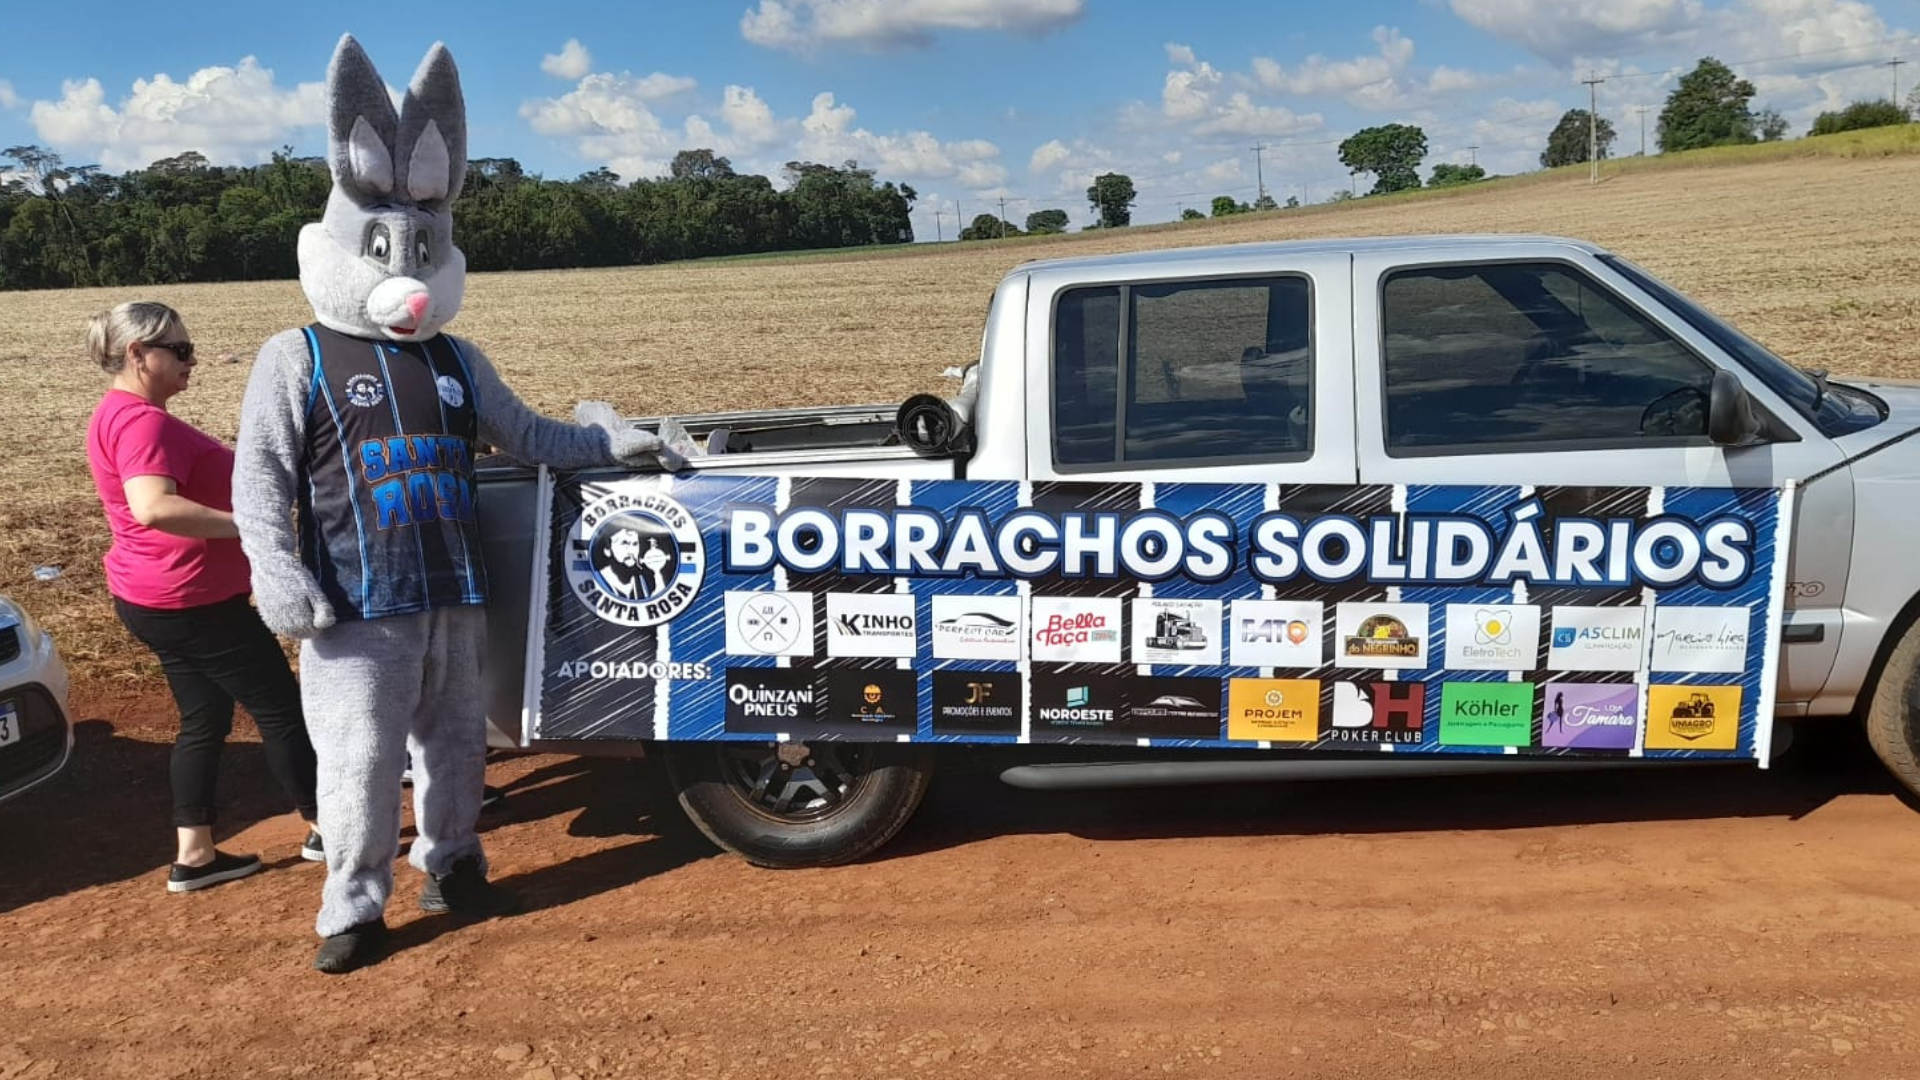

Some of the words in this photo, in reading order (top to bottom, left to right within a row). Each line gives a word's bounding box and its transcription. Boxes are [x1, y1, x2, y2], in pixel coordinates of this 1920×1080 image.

[584, 494, 687, 529] BORRACHOS
[729, 507, 1236, 581] BORRACHOS
[1252, 501, 1751, 584] SOLIDÁRIOS
[578, 579, 640, 621] SANTA
[645, 582, 693, 621] ROSA
[839, 613, 913, 636] KINHO
[1048, 612, 1106, 632] Bella
[984, 627, 1007, 637] CAR
[1036, 628, 1088, 647] Taça
[1578, 626, 1641, 640] ASCLIM
[1362, 643, 1417, 656] NEGRINHO
[1462, 645, 1521, 658] EletroTech
[557, 660, 713, 681] APOIADORES:
[743, 703, 799, 717] PNEUS
[1039, 708, 1114, 721] NOROESTE
[1244, 708, 1303, 720] PROJEM
[1454, 699, 1519, 717] Köhler
[1604, 704, 1624, 712] LOJA
[1565, 705, 1635, 727] Tamara
[1671, 719, 1714, 729] UNIAGRO
[1330, 729, 1384, 742] POKER
[1385, 730, 1423, 744] CLUB
